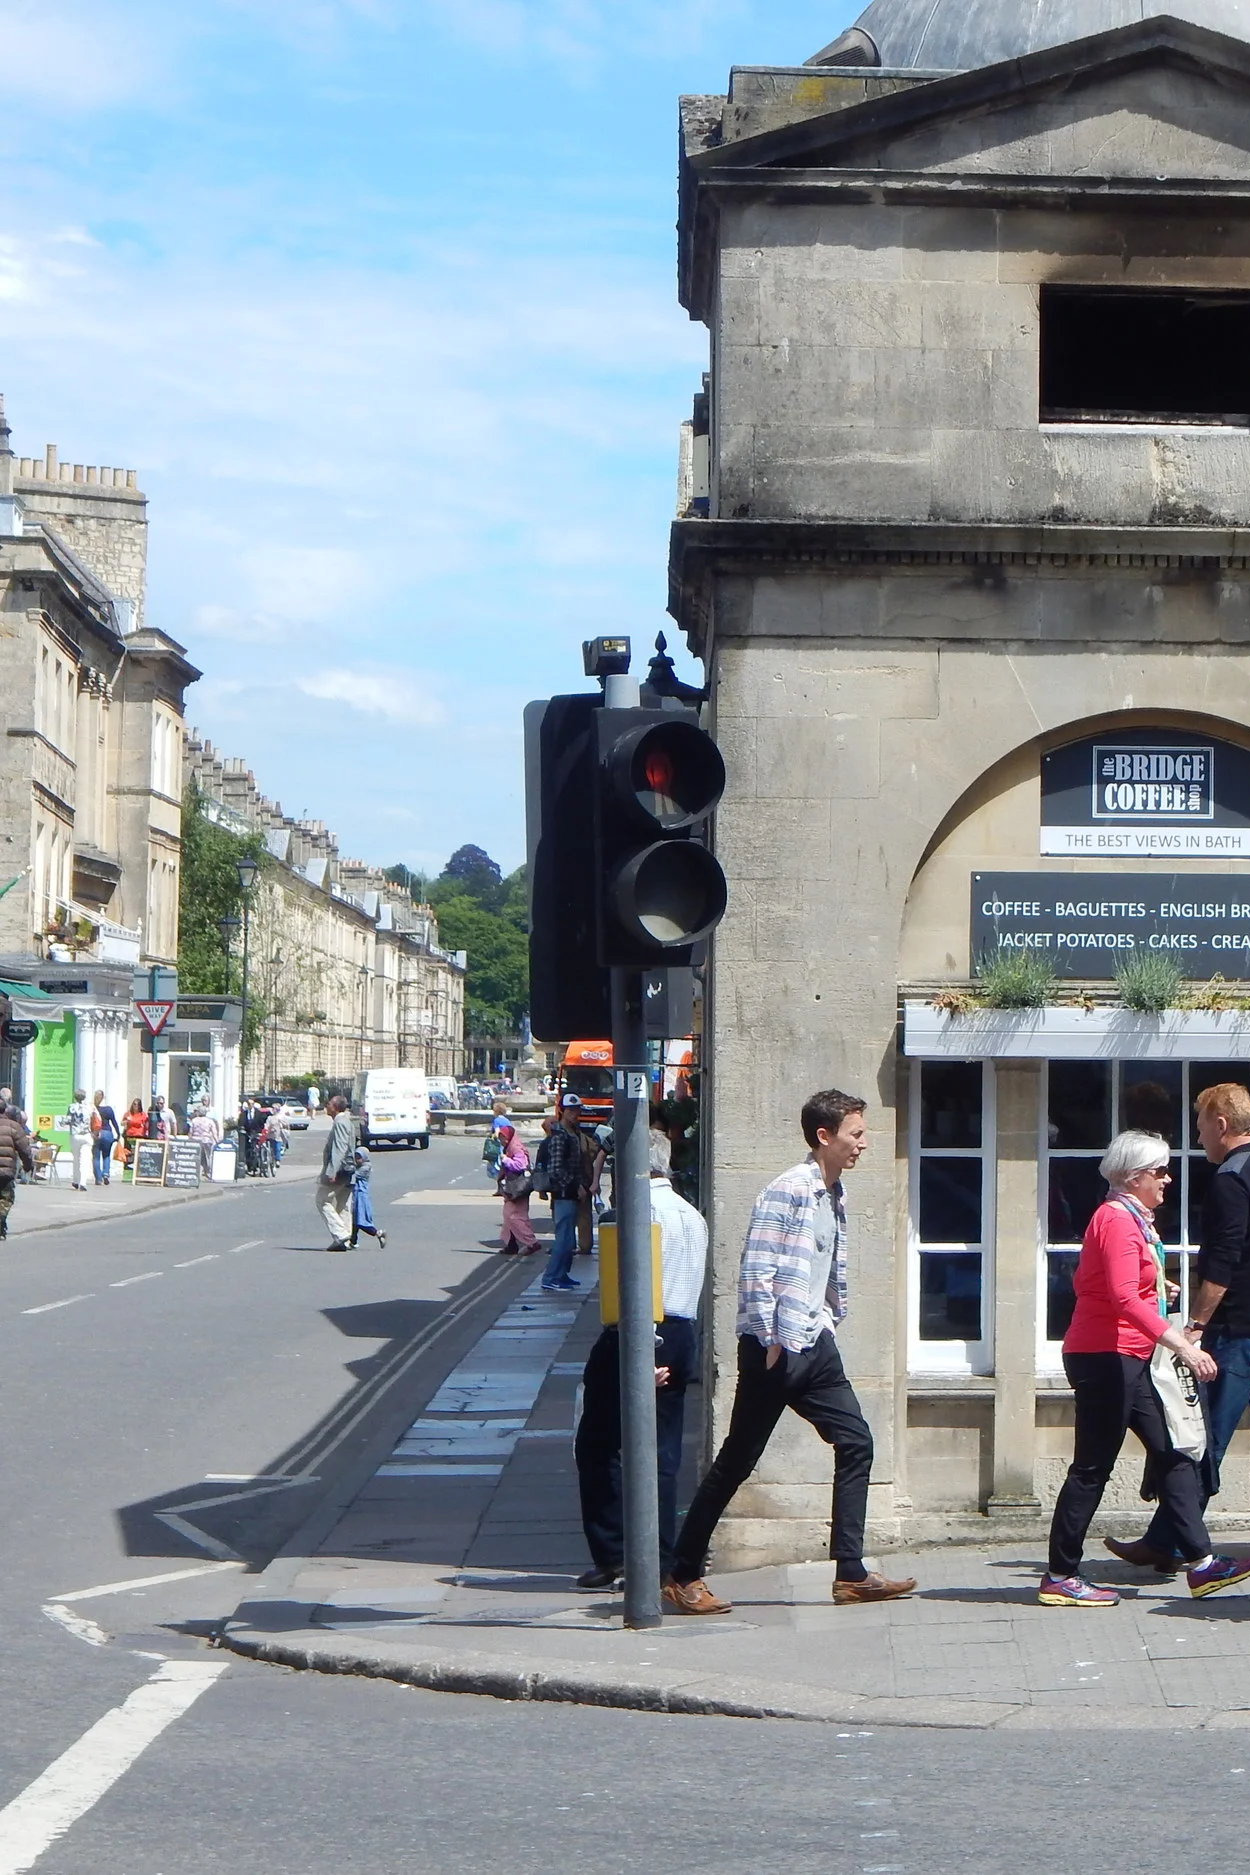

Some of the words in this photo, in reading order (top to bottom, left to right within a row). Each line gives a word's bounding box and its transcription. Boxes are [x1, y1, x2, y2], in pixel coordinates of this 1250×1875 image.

[1102, 757, 1114, 776] the
[1114, 754, 1205, 781] BRIDGE
[1104, 783, 1186, 811] COFFEE
[1187, 784, 1202, 811] shop
[1065, 834, 1093, 847] THE
[1099, 834, 1131, 847] BEST
[1135, 835, 1181, 848] VIEWS
[1186, 835, 1200, 848] IN
[1205, 836, 1241, 848] BATH
[982, 901, 1041, 916] COFFEE
[1055, 902, 1146, 917] BAGUETTES
[1160, 903, 1225, 917] ENGLISH
[998, 933, 1053, 947] JACKET
[1057, 933, 1135, 948] POTATOES
[1149, 934, 1198, 948] CAKES
[633, 1077, 643, 1092] 2
